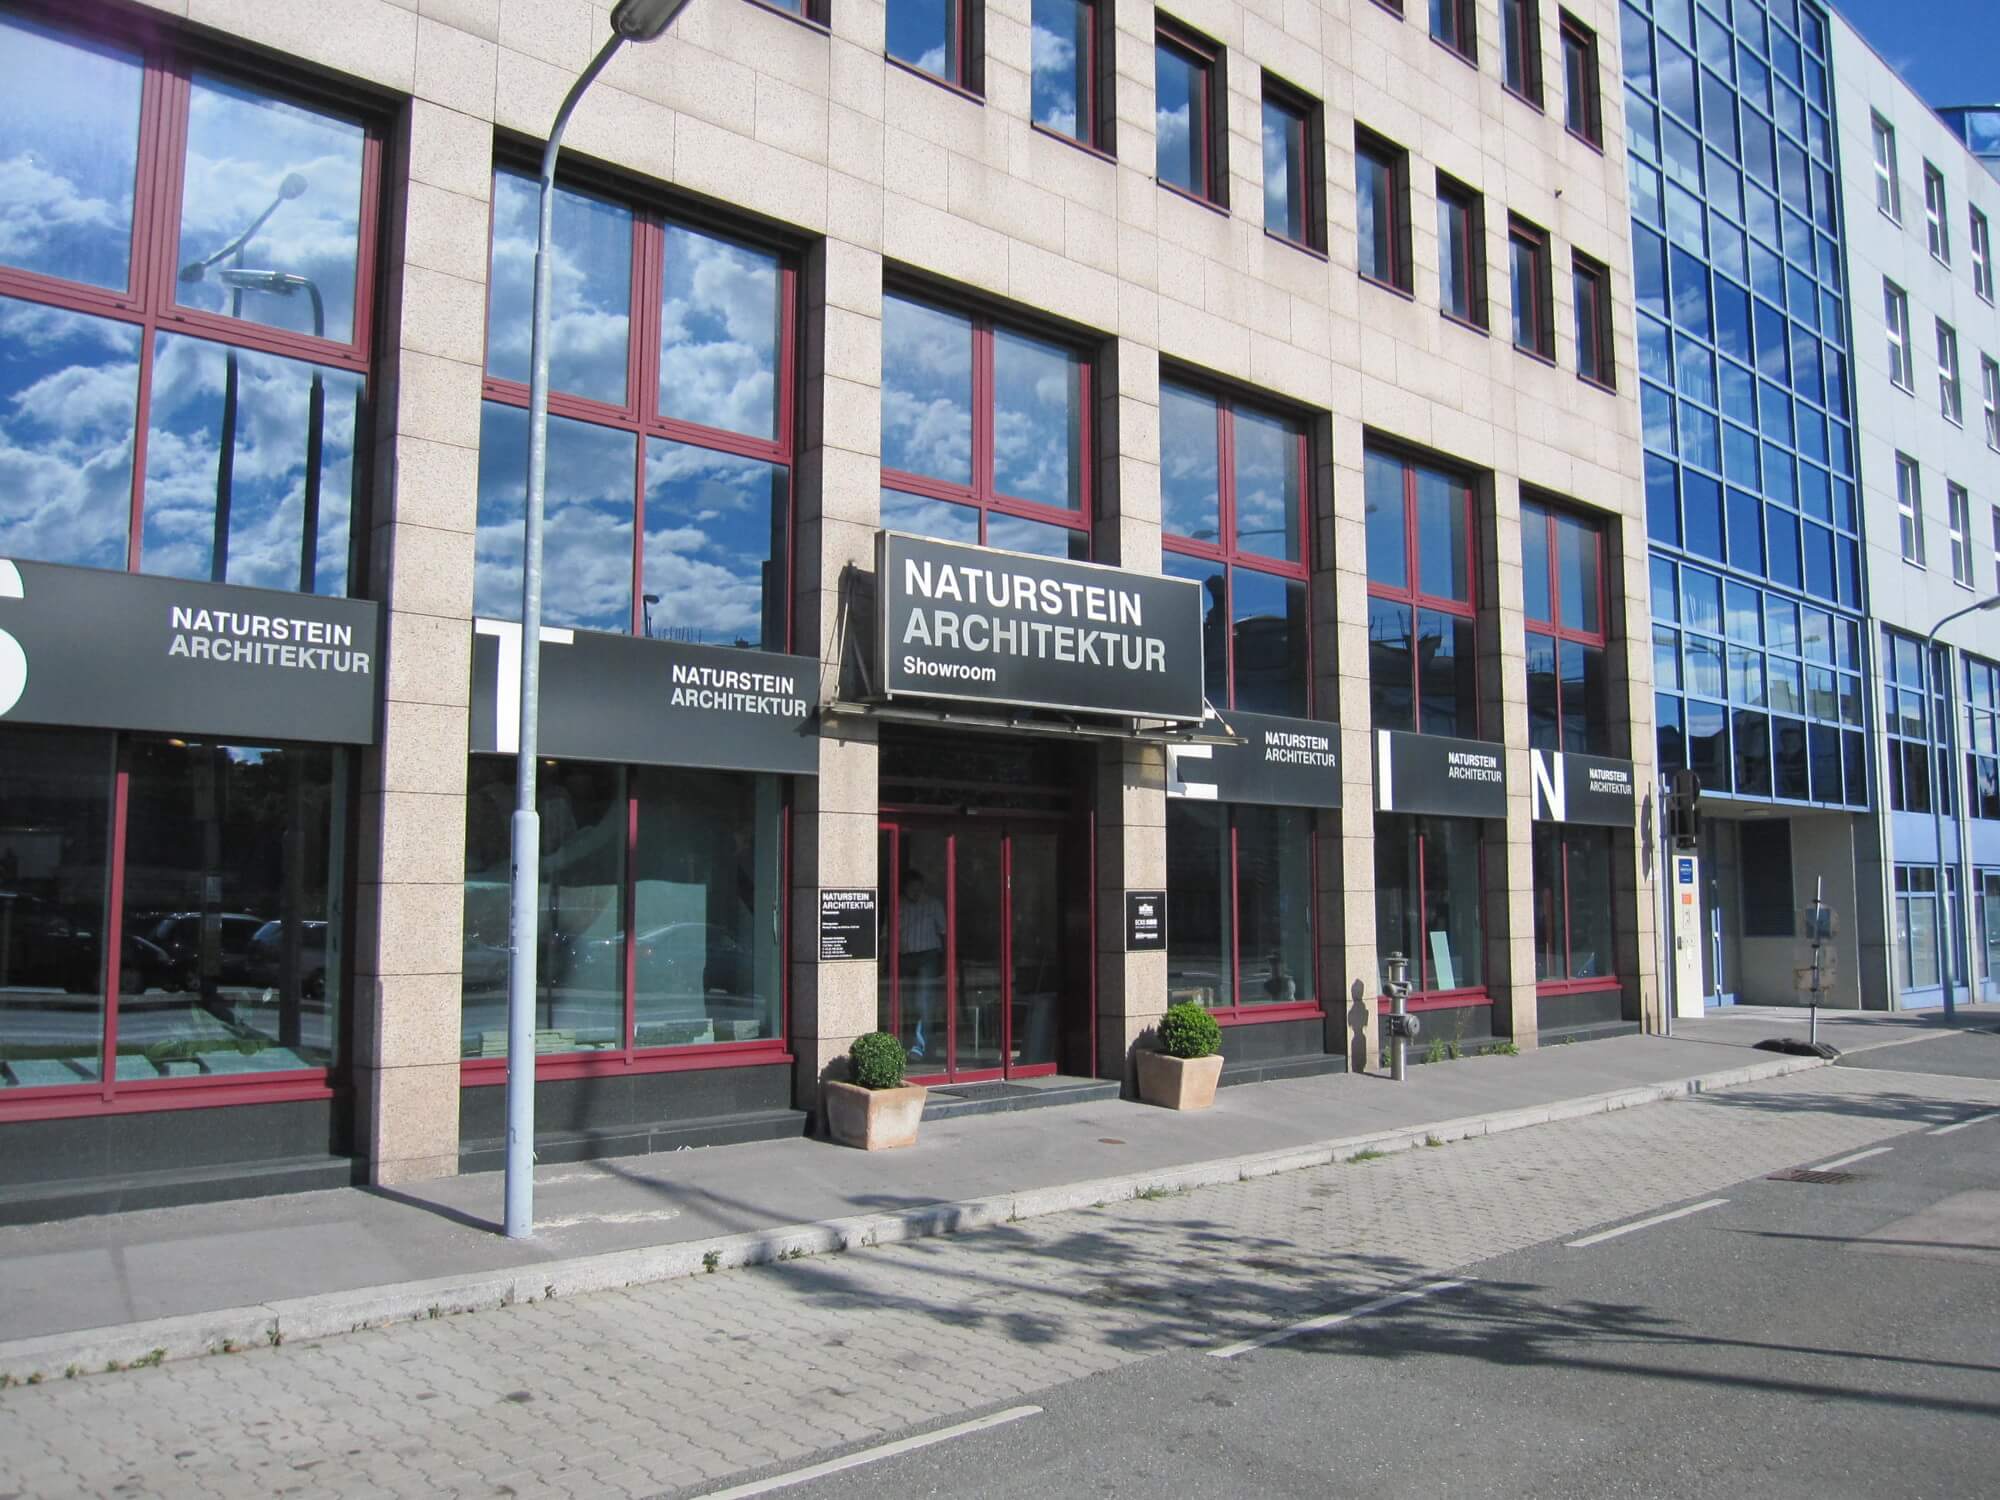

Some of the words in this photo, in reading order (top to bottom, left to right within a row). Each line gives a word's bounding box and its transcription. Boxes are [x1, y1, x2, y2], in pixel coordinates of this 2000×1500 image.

[905, 559, 1142, 626] NATURSTEIN
[171, 606, 352, 646] NATURSTEIN
[903, 608, 1167, 673] ARCHITEKTUR
[168, 634, 370, 674] ARCHITEKTUR
[672, 665, 794, 695] NATURSTEIN
[903, 656, 997, 681] Showroom
[475, 617, 575, 754] T
[671, 688, 807, 717] ARCHITEKTUR
[1265, 731, 1328, 750] NATURSTEIN
[1265, 748, 1335, 767] ARCHITEKTUR
[1448, 752, 1496, 767] NATURSTEIN
[1448, 767, 1502, 782] ARCHITEKTUR
[1530, 748, 1565, 821] N
[1589, 768, 1627, 782] NATURSTEIN
[1589, 781, 1632, 795] ARCHITEKTUR
[822, 893, 869, 901] NATURSTEIN
[822, 901, 874, 910] ARCHITEKTUR
